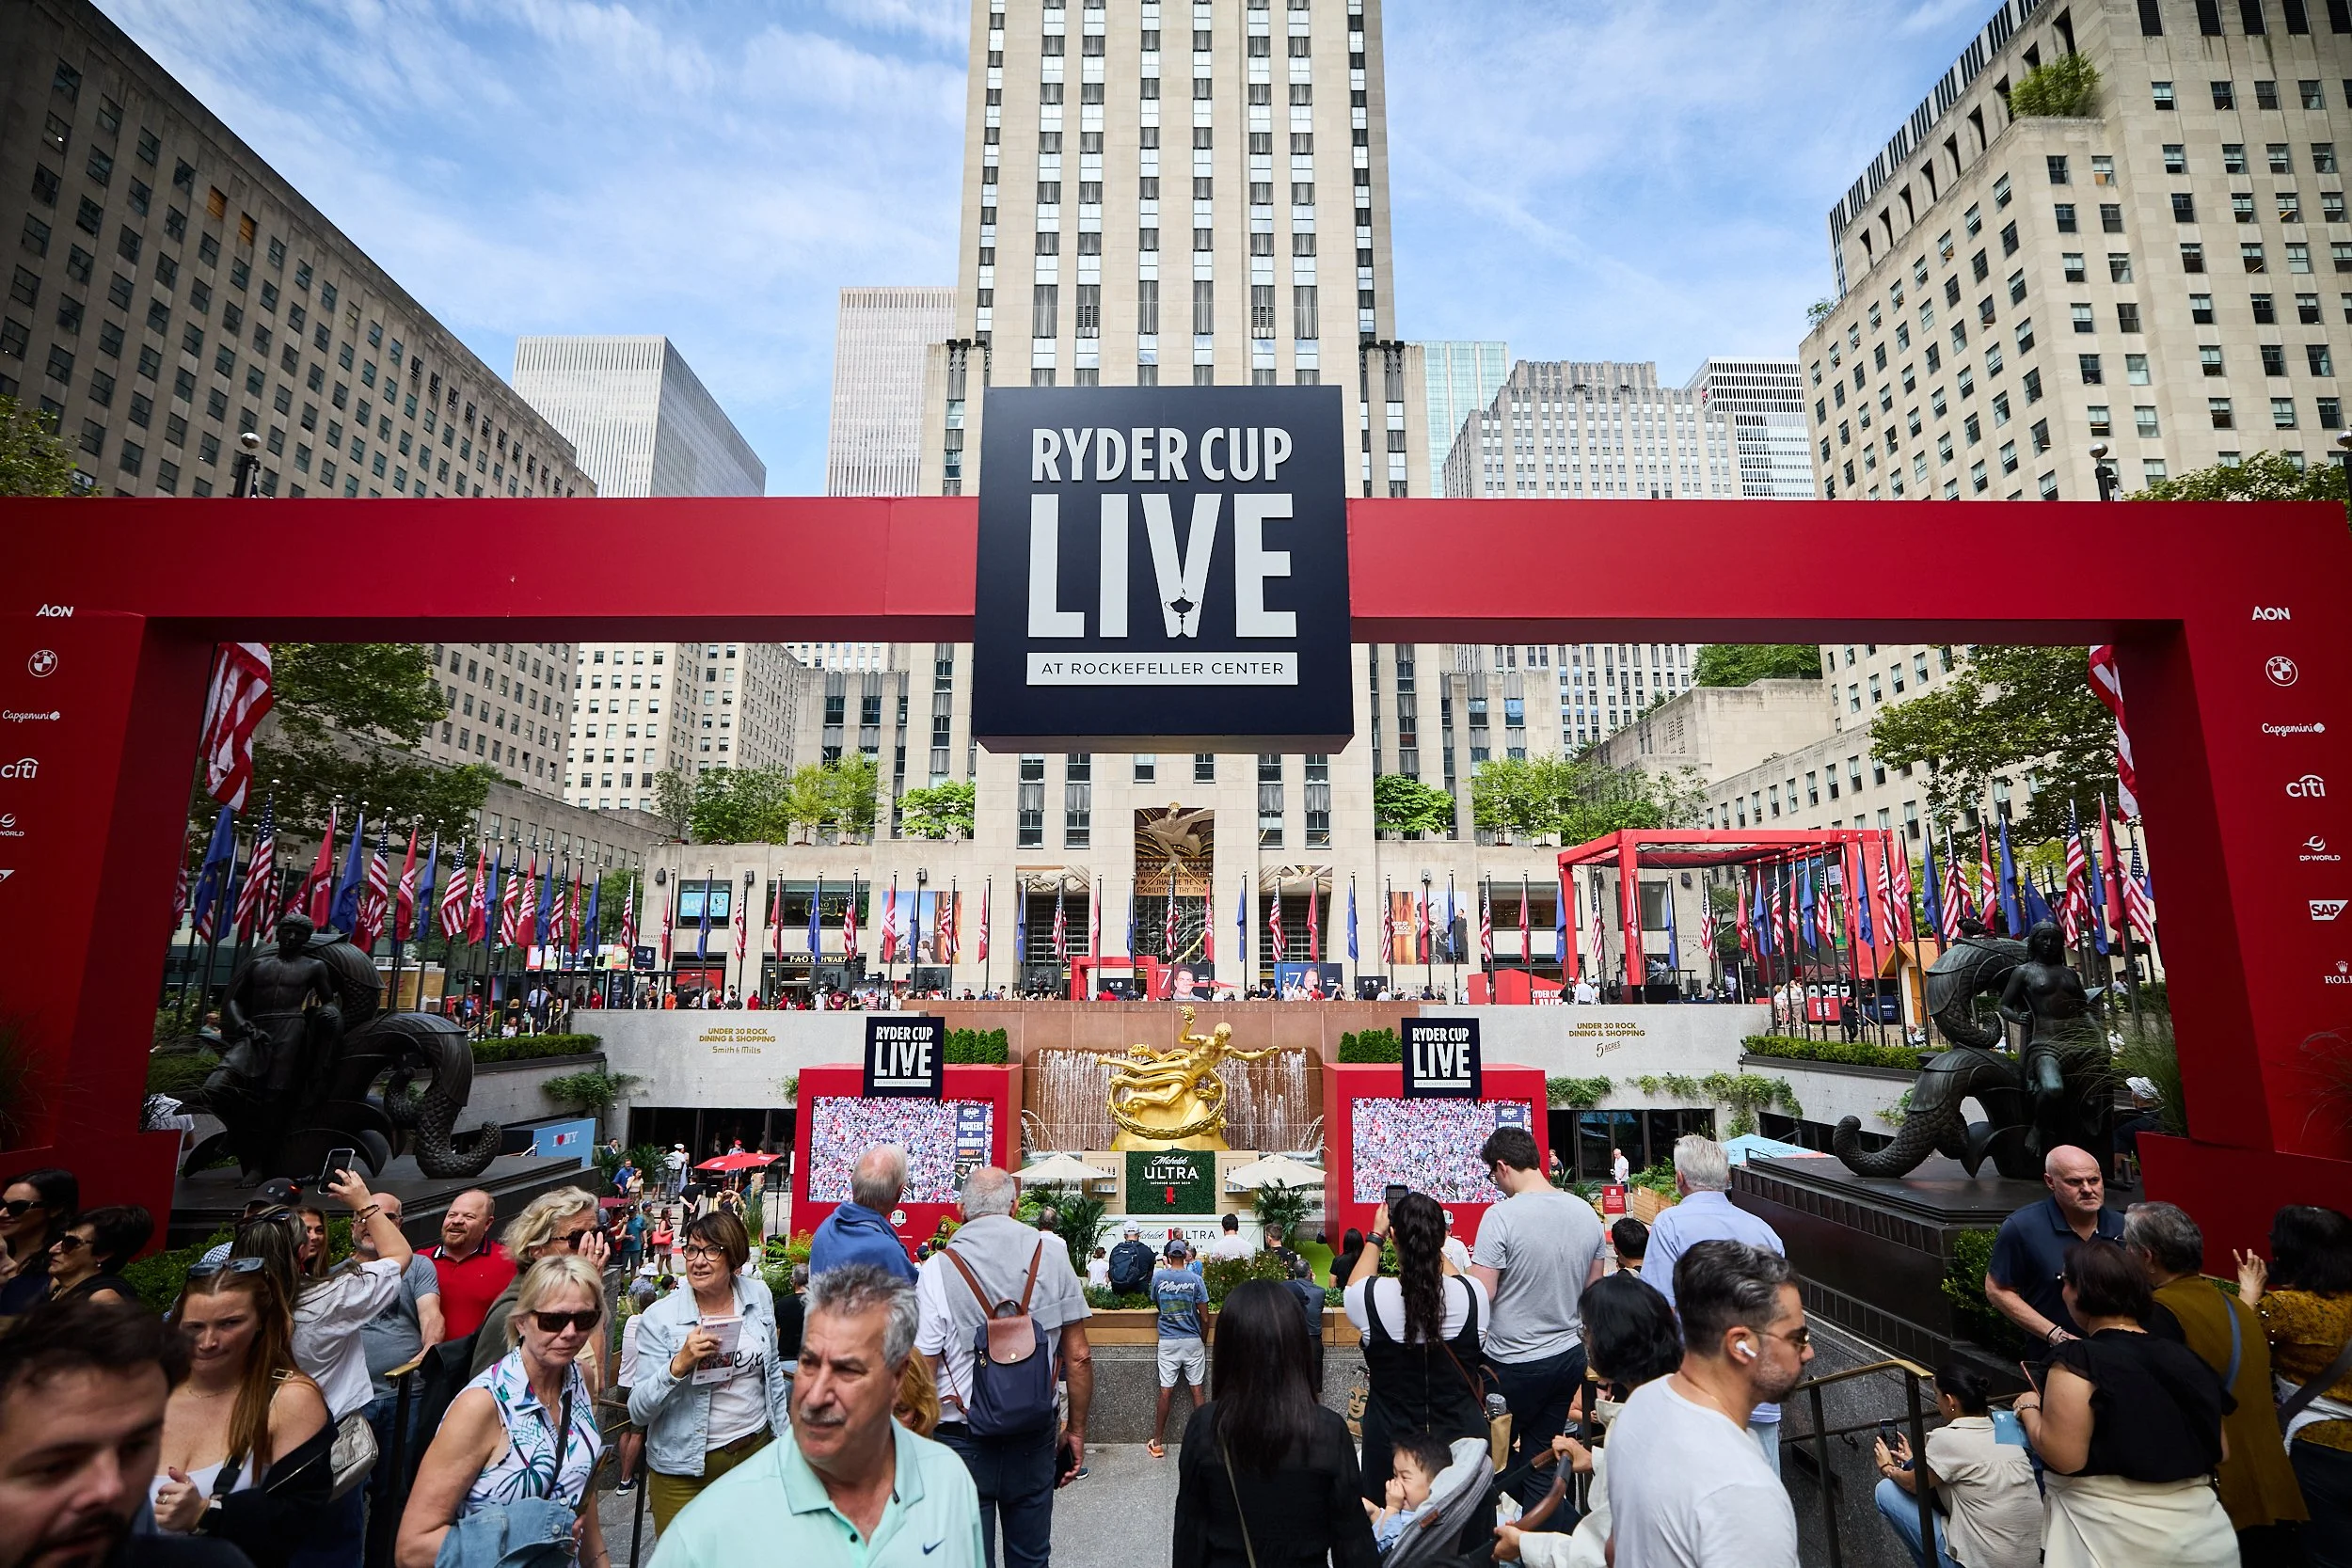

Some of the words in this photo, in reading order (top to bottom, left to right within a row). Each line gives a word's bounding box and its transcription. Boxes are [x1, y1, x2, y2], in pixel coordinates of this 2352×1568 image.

[1031, 427, 1189, 482] RYDER
[1200, 427, 1293, 482] CUP
[1027, 493, 1297, 639] LIVE
[36, 604, 74, 617] AON
[2251, 606, 2291, 621] AON
[1041, 662, 1063, 674] AT
[1071, 662, 1204, 674] ROCKEFELLER
[1211, 662, 1284, 674] CENTER
[2, 709, 50, 722] Capgemini
[2262, 722, 2314, 737] Capgemini
[1, 758, 39, 779] citi
[2285, 774, 2326, 798] citi
[2311, 904, 2340, 917] SAP
[810, 955, 848, 963] SHWARZ
[876, 1026, 911, 1040] RYDER
[912, 1026, 933, 1040] CUP
[1412, 1027, 1447, 1041] RYDER
[1448, 1027, 1470, 1041] CUP
[1596, 1042, 1604, 1058] 5
[1604, 1040, 1621, 1052] ACRES
[874, 1041, 933, 1077] LIVE
[1412, 1043, 1471, 1078] LIVE
[959, 1121, 984, 1132] PACKERS
[957, 1137, 984, 1148] COWBOYS
[1151, 1155, 1189, 1165] Michelob
[1144, 1166, 1200, 1180] ULTRA
[1185, 1230, 1216, 1240] LTRA
[1157, 1280, 1196, 1294] Players
